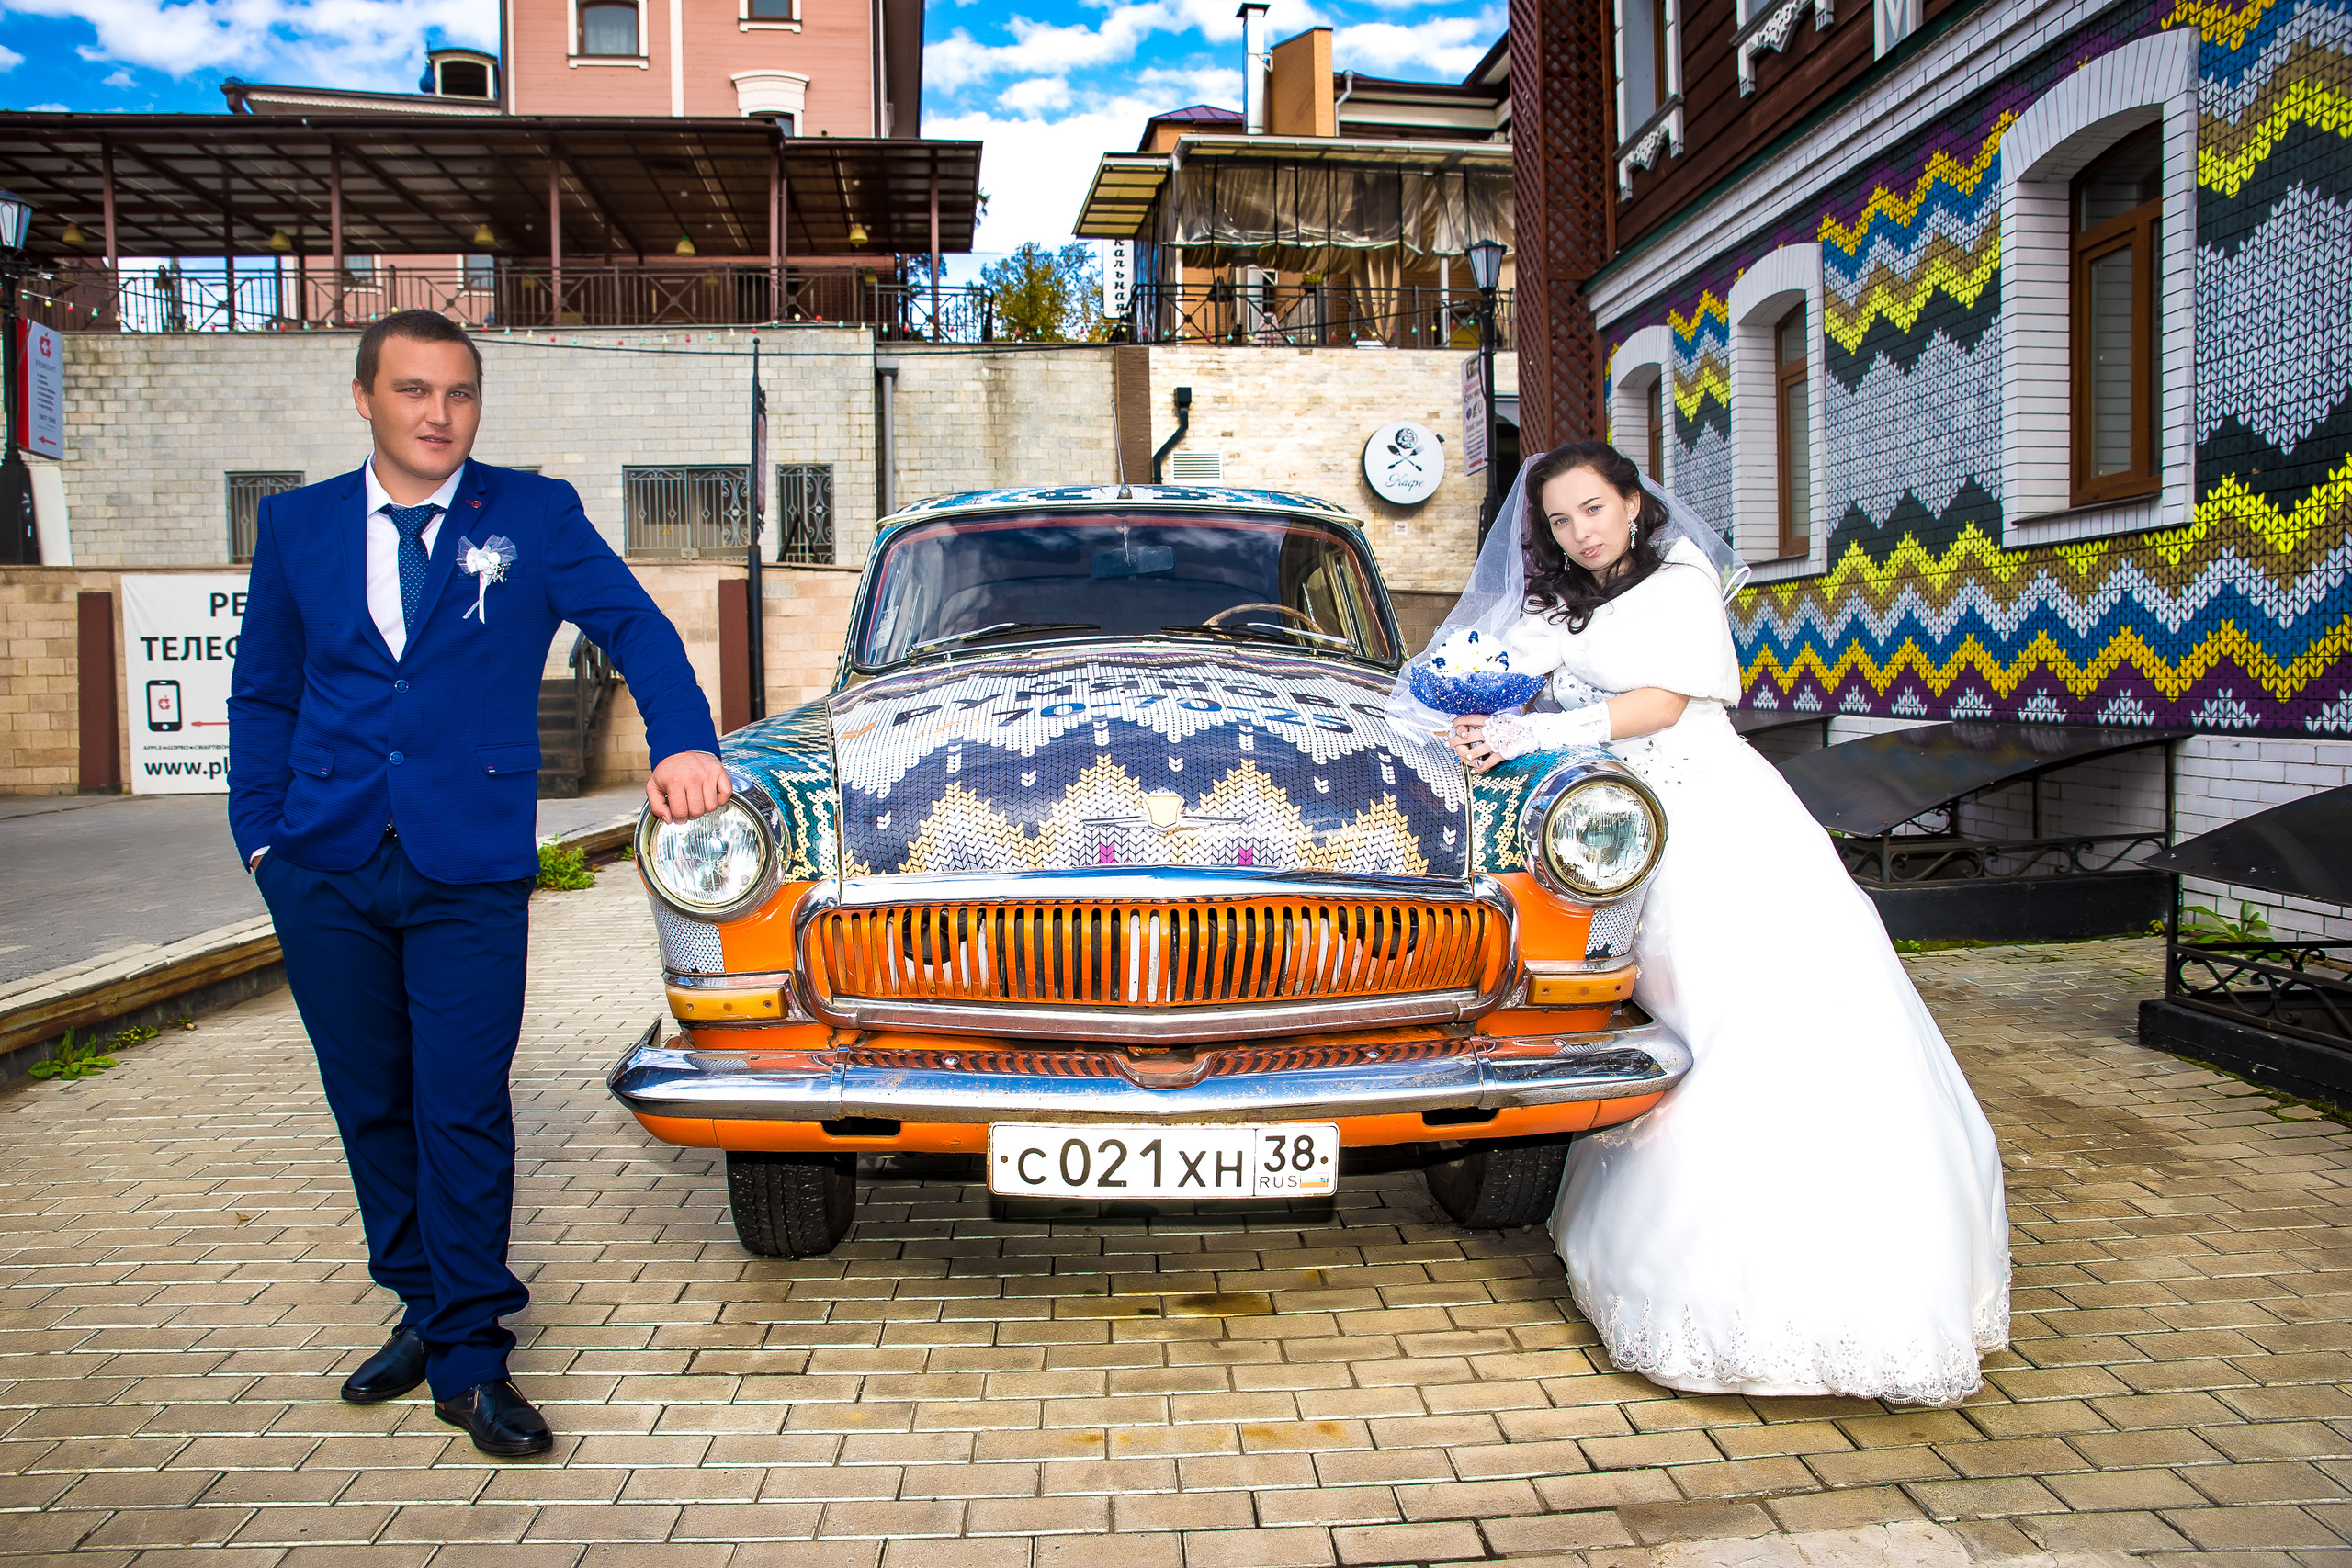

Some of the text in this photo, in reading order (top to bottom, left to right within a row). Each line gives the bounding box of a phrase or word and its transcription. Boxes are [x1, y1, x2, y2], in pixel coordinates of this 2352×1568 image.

[1385, 473, 1424, 491] Кафе
[992, 694, 1354, 734] 70-70-25
[144, 756, 229, 780] www.pl
[1263, 1135, 1316, 1172] 38
[1260, 1175, 1297, 1188] RUS
